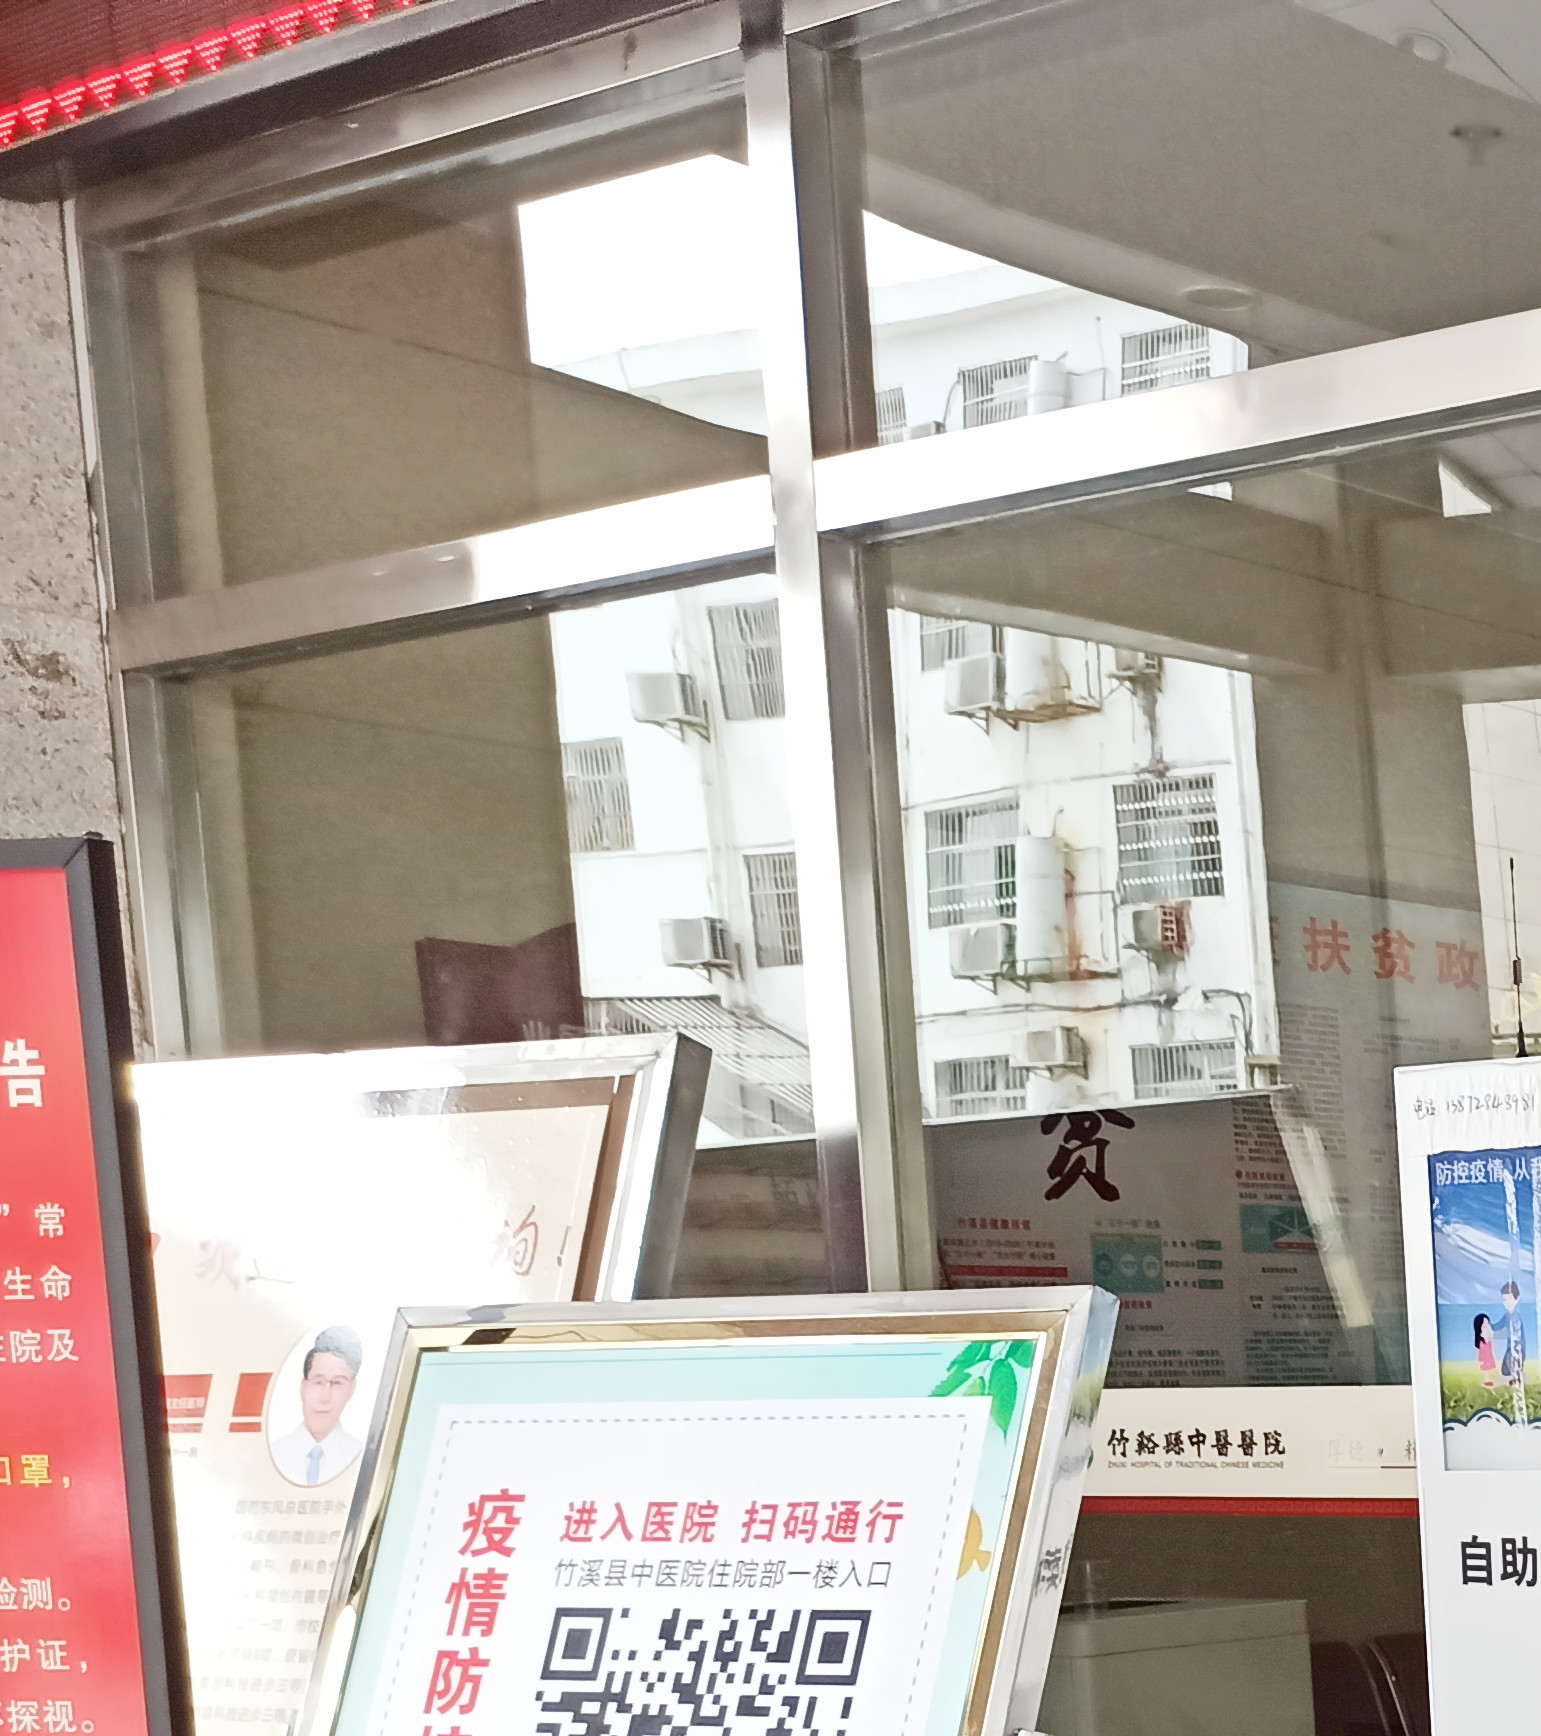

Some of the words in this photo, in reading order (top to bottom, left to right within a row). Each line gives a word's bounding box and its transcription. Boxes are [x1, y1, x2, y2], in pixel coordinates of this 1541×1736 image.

[1, 1038, 46, 1108] 告
[3, 1264, 73, 1301] 生命
[0, 1328, 80, 1363] 院及
[560, 1500, 719, 1543] 进入医院
[740, 1498, 904, 1544] 扫码通行
[553, 1558, 892, 1590] 竹溪县中医院住院部一楼入口
[0, 1700, 95, 1735] 探视。
